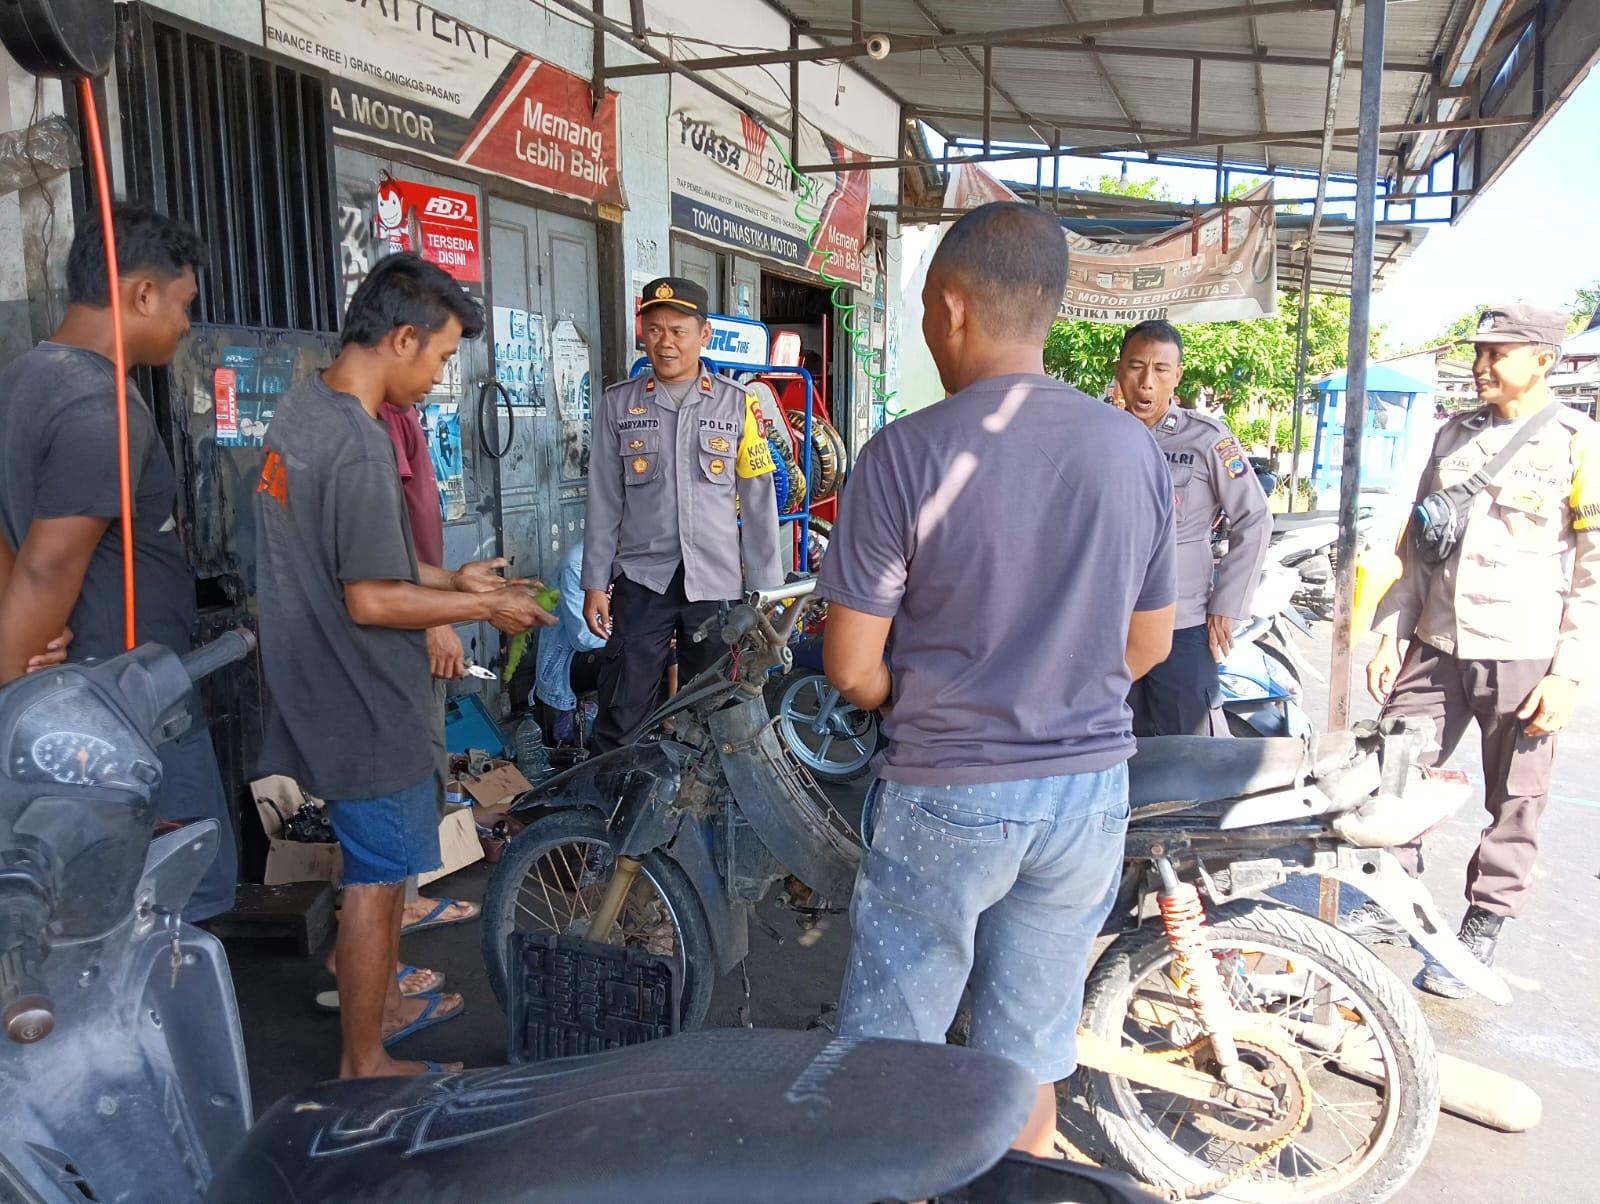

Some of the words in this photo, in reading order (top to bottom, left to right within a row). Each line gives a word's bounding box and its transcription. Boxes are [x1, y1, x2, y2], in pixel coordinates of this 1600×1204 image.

[316, 44, 341, 64] FREE
[350, 57, 382, 79] GRATIS
[384, 70, 425, 93] ONGKOS
[426, 83, 461, 105] PASANG
[351, 93, 436, 145] MOTOR
[523, 97, 603, 162] Memang
[516, 130, 565, 173] Lebih
[570, 148, 609, 187] Baik
[679, 111, 742, 171] YUASA
[766, 157, 823, 207] BATRY
[424, 195, 469, 220] FDR
[426, 233, 474, 252] TERSEDIA
[692, 208, 721, 234] TOKO
[723, 218, 770, 251] PINASTIKA
[770, 234, 798, 259] MOTOR
[828, 225, 859, 256] Memang
[438, 251, 466, 266] DISINI
[1078, 292, 1129, 306] MOTOR
[1132, 283, 1230, 305] BERKUALITAS
[1114, 307, 1169, 320] MOTOR
[618, 419, 659, 431] MARYANTO
[700, 419, 737, 433] POLRI
[750, 455, 767, 471] SEK
[1163, 453, 1195, 465] OLRI
